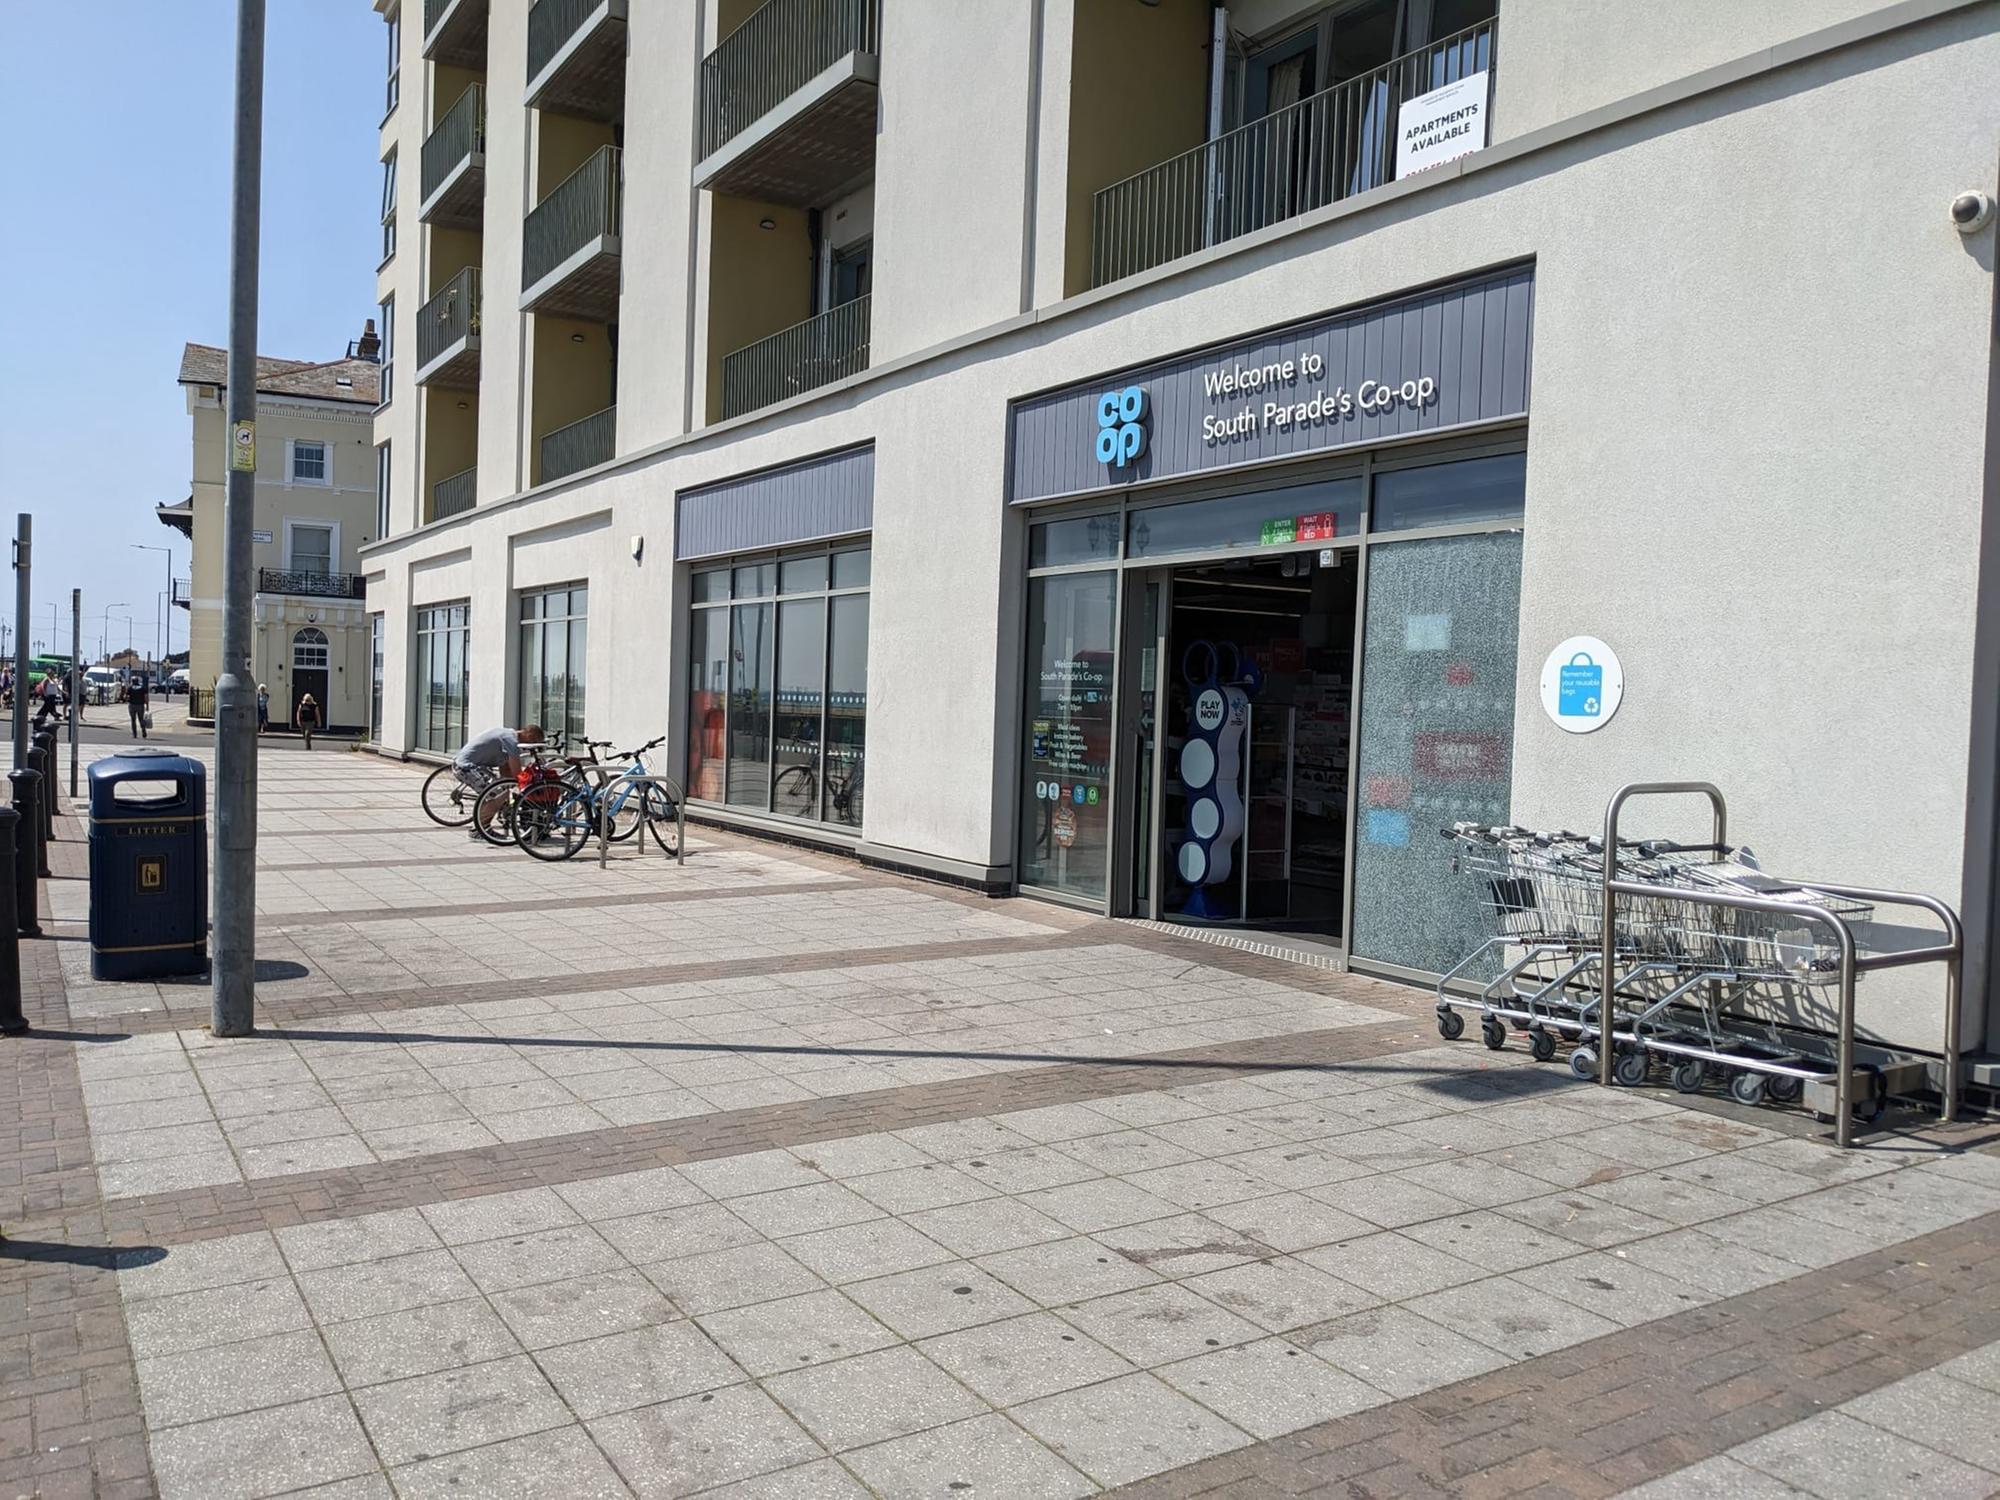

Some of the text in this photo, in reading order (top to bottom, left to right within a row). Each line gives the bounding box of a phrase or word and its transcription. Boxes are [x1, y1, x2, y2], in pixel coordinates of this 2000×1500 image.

[1405, 103, 1479, 141] APARTMENTS
[1410, 122, 1471, 154] AVAILABLE
[1203, 353, 1322, 397] Welcome to
[1202, 376, 1434, 440] South Parade's Co-op
[1054, 660, 1081, 669] Welcome
[1040, 671, 1057, 681] South
[1083, 671, 1103, 684] Co-op
[1562, 670, 1594, 678] Remember
[1562, 680, 1575, 688] your
[1200, 700, 1221, 710] PLAY
[1200, 709, 1220, 719] NOW
[128, 826, 176, 835] LITTER
